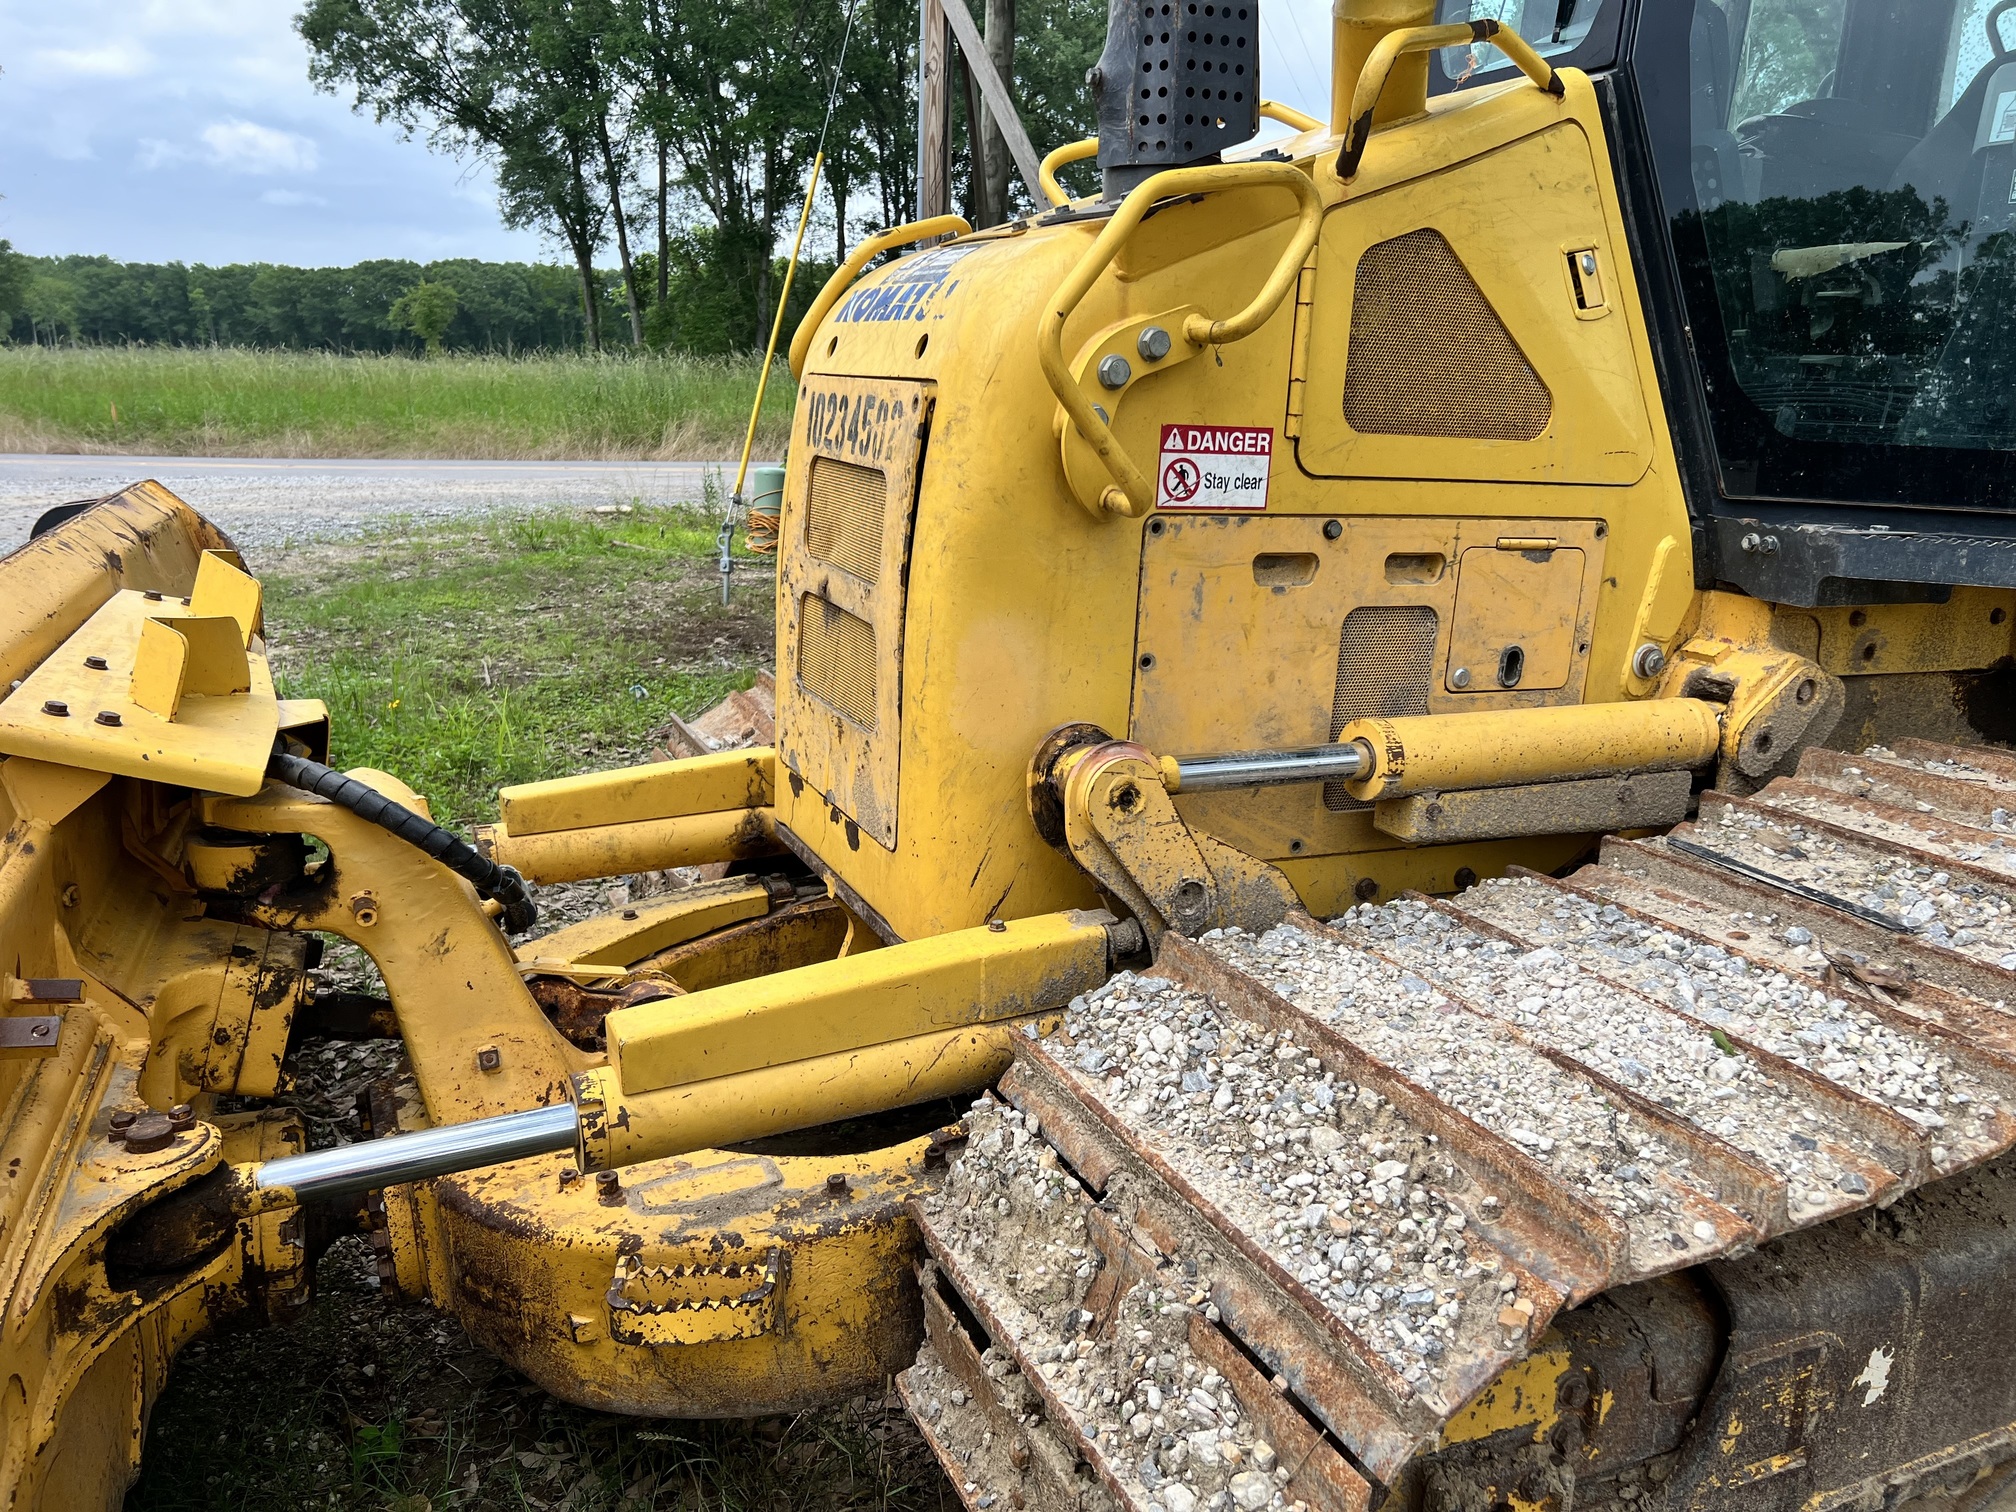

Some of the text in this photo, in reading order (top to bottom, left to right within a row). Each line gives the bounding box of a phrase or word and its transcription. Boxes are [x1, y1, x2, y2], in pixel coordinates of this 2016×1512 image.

[1187, 430, 1271, 453] DANGER
[1204, 472, 1263, 494] Stay clear
